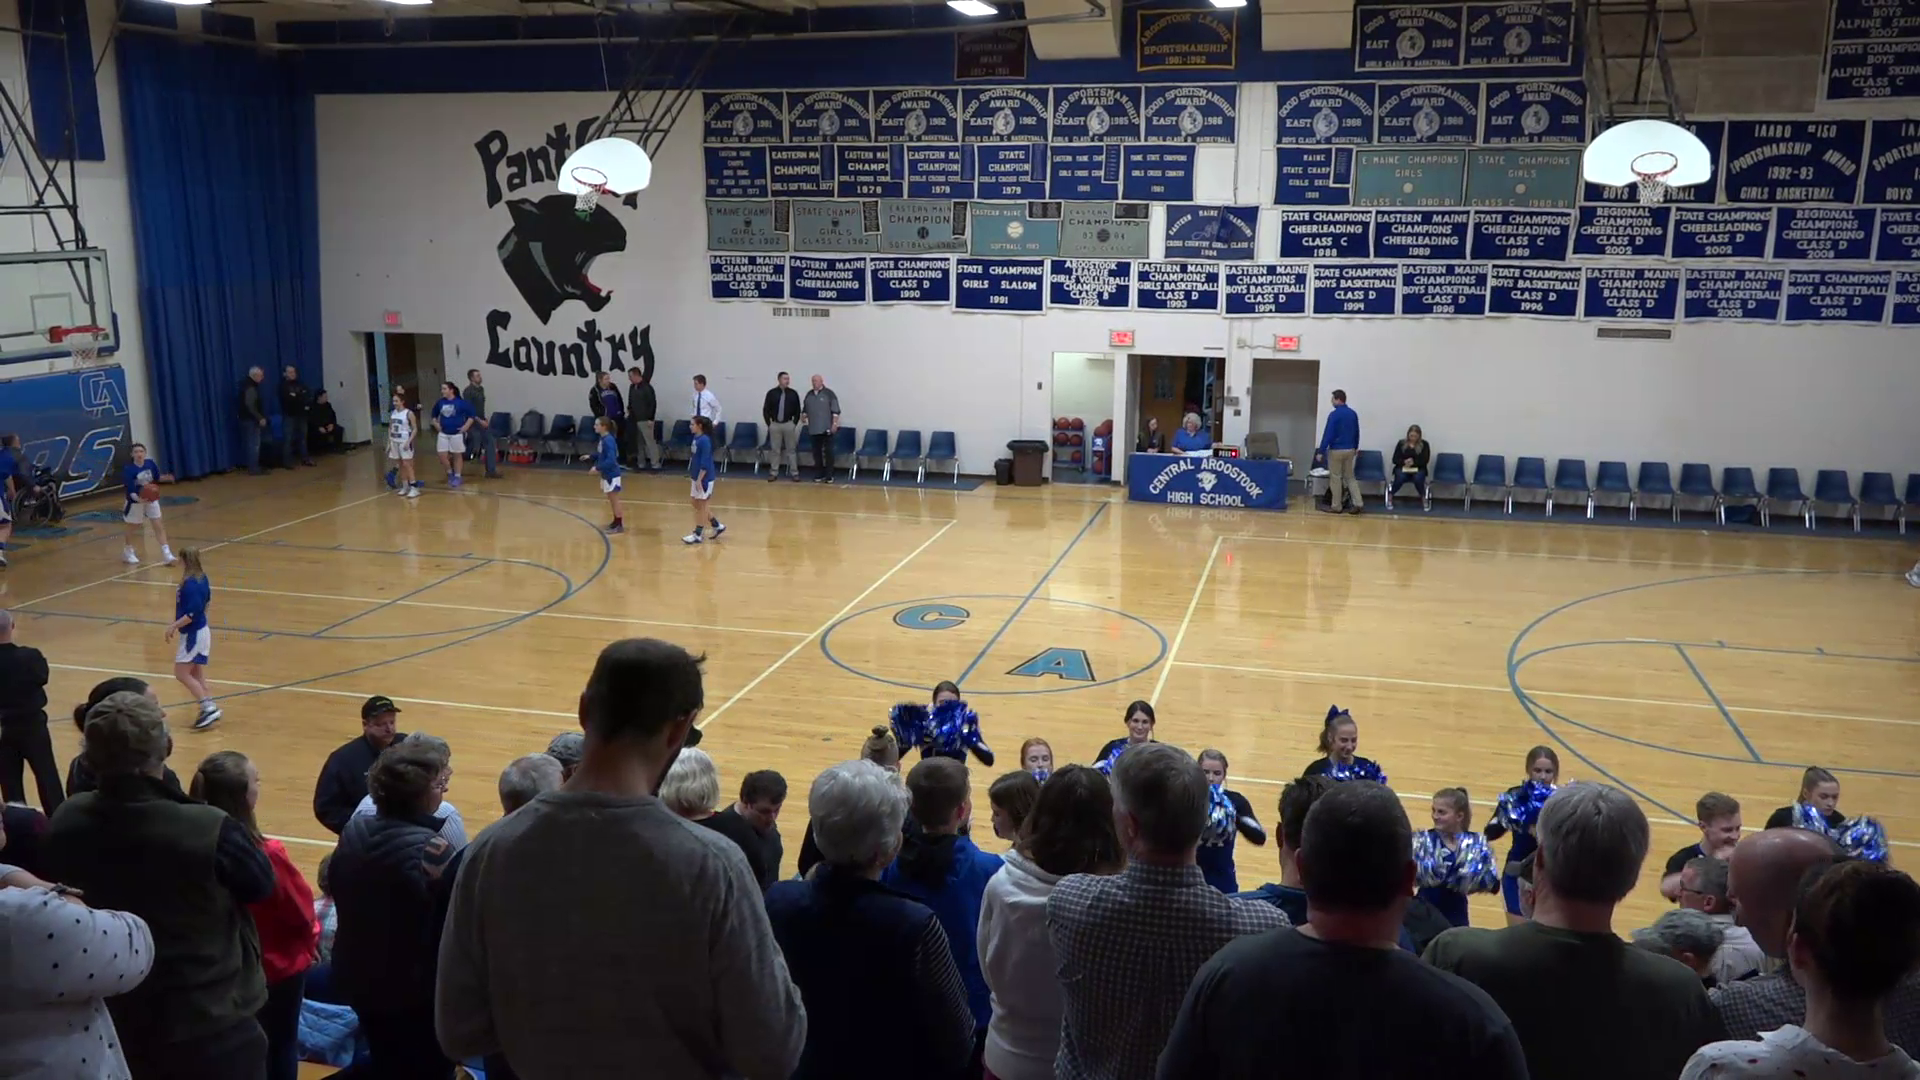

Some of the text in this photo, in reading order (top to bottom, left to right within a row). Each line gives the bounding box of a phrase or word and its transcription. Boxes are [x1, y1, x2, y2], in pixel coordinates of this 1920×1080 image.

[1873, 7, 1902, 17] BOYS
[1837, 18, 1882, 29] ALPINE
[1832, 45, 1864, 55] STATE
[1867, 55, 1895, 65] BOYS
[1831, 66, 1873, 78] ALPINE
[1852, 76, 1904, 87] CLASS C
[990, 100, 1020, 108] AWARD
[1279, 86, 1372, 118] GOOD SPORTSMANSHIP
[1309, 99, 1342, 107] AWARD
[971, 117, 993, 125] EAST
[1286, 119, 1312, 127] EAST
[1755, 125, 1792, 138] IAABO
[999, 151, 1025, 159] STATE
[1822, 150, 1856, 176] AWARD
[1768, 167, 1814, 180] 1992-93
[1740, 187, 1834, 200] GIRLS BASKETBALL
[1597, 208, 1650, 217] REGIONAL
[1675, 212, 1771, 221] STATE CHAMPIONS
[1796, 210, 1855, 219] REGIONAL
[1282, 213, 1371, 222] STATE CHAMPIONS
[1377, 214, 1468, 223] EASTERN MAINE
[1475, 214, 1570, 226] STATE CHAMPIONS
[1593, 217, 1652, 226] CHAMPION
[1680, 223, 1763, 232] CHEERLEADING
[1790, 220, 1858, 229] CHAMPIONS
[1289, 225, 1363, 234] CHEERLEADING
[1391, 225, 1452, 234] CHAMPIONS
[1482, 225, 1561, 236] CHEERLEADING
[1581, 227, 1663, 236] CHEERLEADING
[1695, 234, 1744, 243] CLASS D
[1782, 231, 1864, 240] CHEERLEADING
[1302, 238, 1347, 246] CLASS C
[1383, 236, 1459, 245] CHEERLEADING
[1495, 237, 1544, 246] CLASS C
[1597, 237, 1644, 245] CLASS D
[1797, 241, 1847, 249] CLASS D
[1605, 246, 1632, 254] 2002
[1705, 246, 1733, 255] 2002
[711, 257, 785, 265] EASTERN MAINE
[791, 259, 865, 269] EASTERN MAINE
[870, 261, 949, 269] STATE CHAMPIONS
[1065, 261, 1117, 270] AROOSTOOK
[722, 265, 774, 273] CHAMPIONS
[958, 265, 1043, 275] STATE CHAMPIONS
[1139, 264, 1218, 273] EASTERN MAINE
[1225, 266, 1308, 275] EASTERN MAINE
[1314, 268, 1397, 277] STATE CHAMPIONS
[711, 273, 784, 282] GIRLS BASKETBALL
[803, 271, 853, 279] CHAMPIONS
[1149, 273, 1206, 282] CHAMPIONS
[1492, 268, 1580, 279] STATE CHAMPIONS
[1587, 270, 1679, 279] EASTERN MAINE
[1051, 275, 1130, 285] GIRLS VOLLEYBALL
[1236, 276, 1296, 284] CHAMPIONS
[1825, 275, 1890, 283] CHAMPIONS
[796, 279, 859, 289] CHEERLEADING
[890, 280, 930, 288] CLASS D
[963, 280, 1037, 290] GIRLS SLALOM
[1064, 283, 1116, 292] CHAMPIONS
[1138, 282, 1218, 291] GIRLS BASKETBALL
[1314, 280, 1396, 288] BOYS BASKETBALL
[1491, 279, 1579, 290] BOYS BASKETBALL
[1599, 280, 1666, 289] CHAMPIONS
[900, 290, 920, 298] 1990
[1226, 285, 1305, 294] BOYS BASKETBALL
[1603, 289, 1658, 298] BASEBALL
[1789, 287, 1889, 296] BOYS BASKETBALL
[1070, 291, 1097, 299] CLASS
[1155, 292, 1198, 300] CLASS D
[1245, 295, 1286, 303] CLASS D
[1335, 291, 1376, 299] CLASS D
[1511, 291, 1556, 301] CLASS D
[990, 296, 1008, 304] 1991
[1166, 300, 1187, 308] 1993
[1606, 299, 1640, 307] CLASS
[1810, 297, 1862, 305] CLASS D
[1255, 304, 1275, 312] 1994
[1343, 303, 1365, 311] 1994
[1520, 302, 1543, 310] 1996
[1616, 309, 1642, 317] 2003
[486, 309, 655, 384] Country
[1150, 458, 1263, 500] CENTRAL AROOSTOOK
[1167, 491, 1245, 508] HIGH SCHOOL
[893, 604, 970, 630] C
[1005, 647, 1097, 682] A
